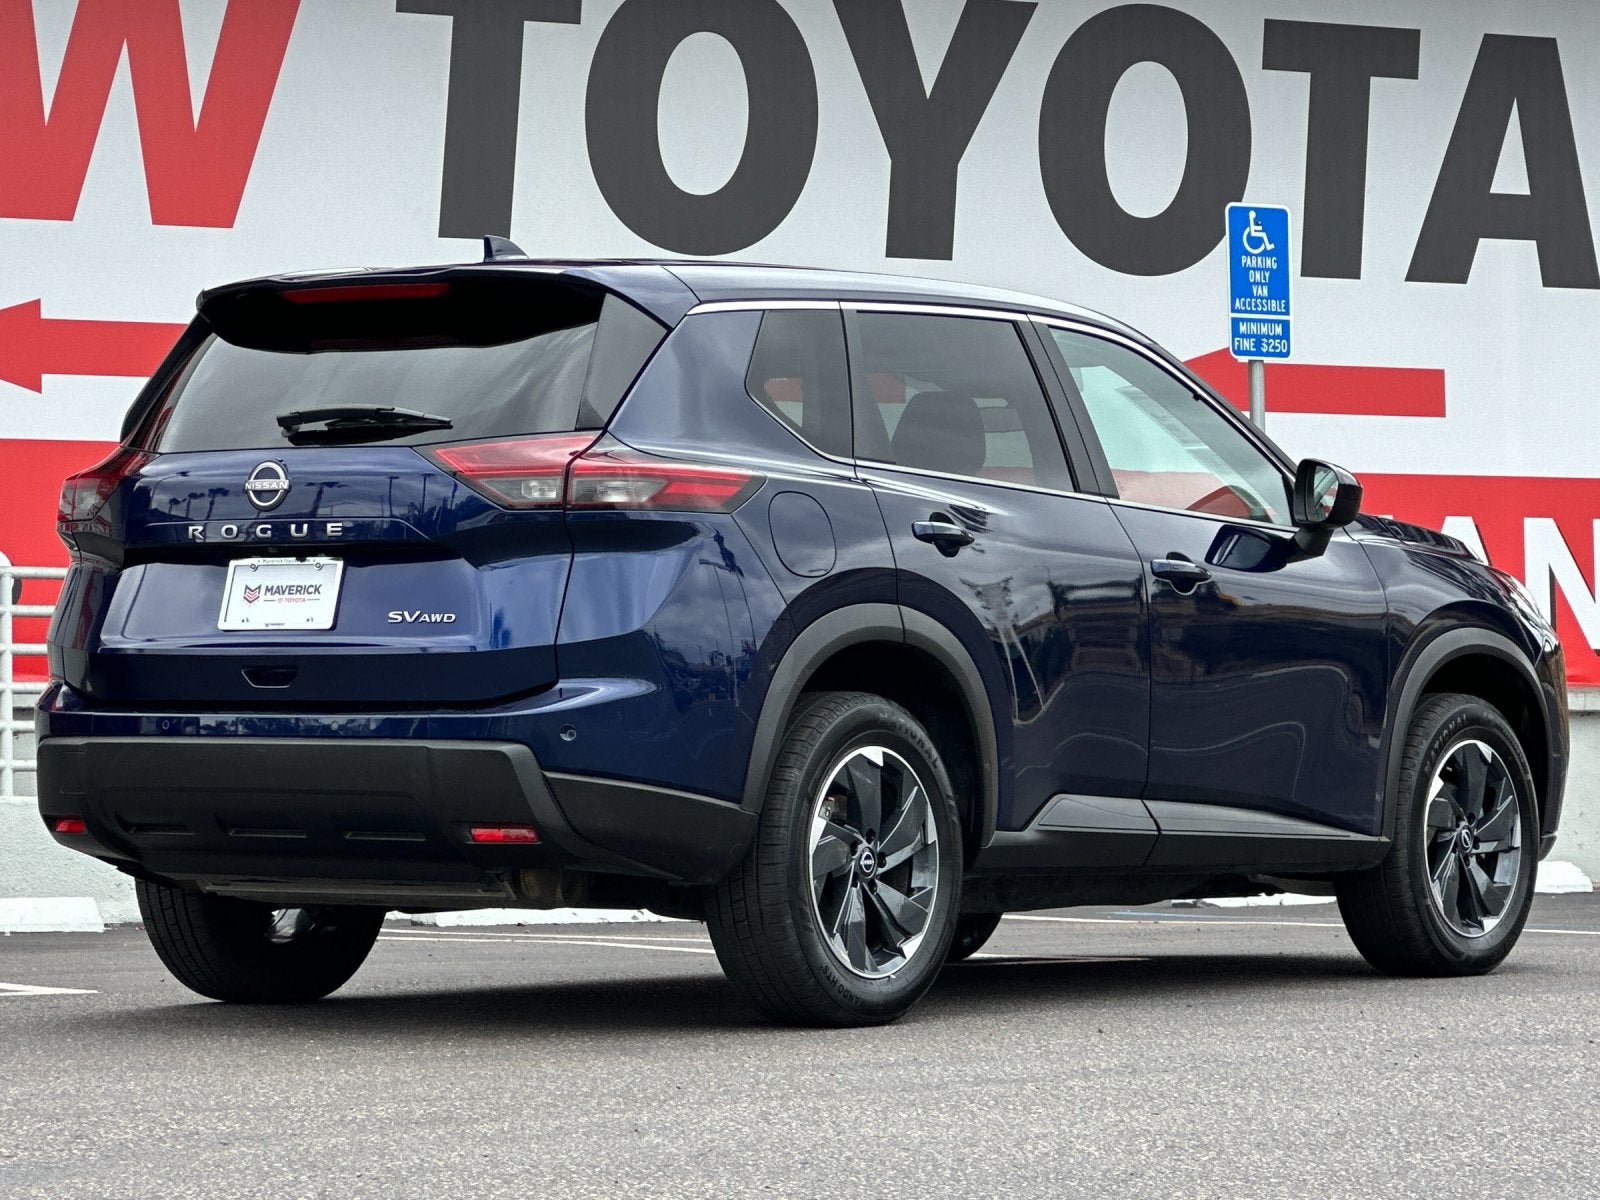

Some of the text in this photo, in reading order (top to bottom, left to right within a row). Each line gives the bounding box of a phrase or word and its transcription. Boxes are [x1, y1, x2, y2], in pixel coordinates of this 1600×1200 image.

[396, 0, 1600, 290] TOYOTA
[1241, 255, 1277, 269] PARKING
[1249, 270, 1270, 283] ONLY
[1252, 285, 1268, 297] VAN
[1235, 297, 1286, 312] ACCESSIBLE
[1239, 321, 1282, 336] MINIMUM
[1234, 337, 1288, 353] FINE $250
[245, 480, 289, 490] NISSAN
[188, 522, 343, 540] ROGUE
[264, 584, 323, 596] MAVERICK
[387, 610, 456, 623] SV AWD
